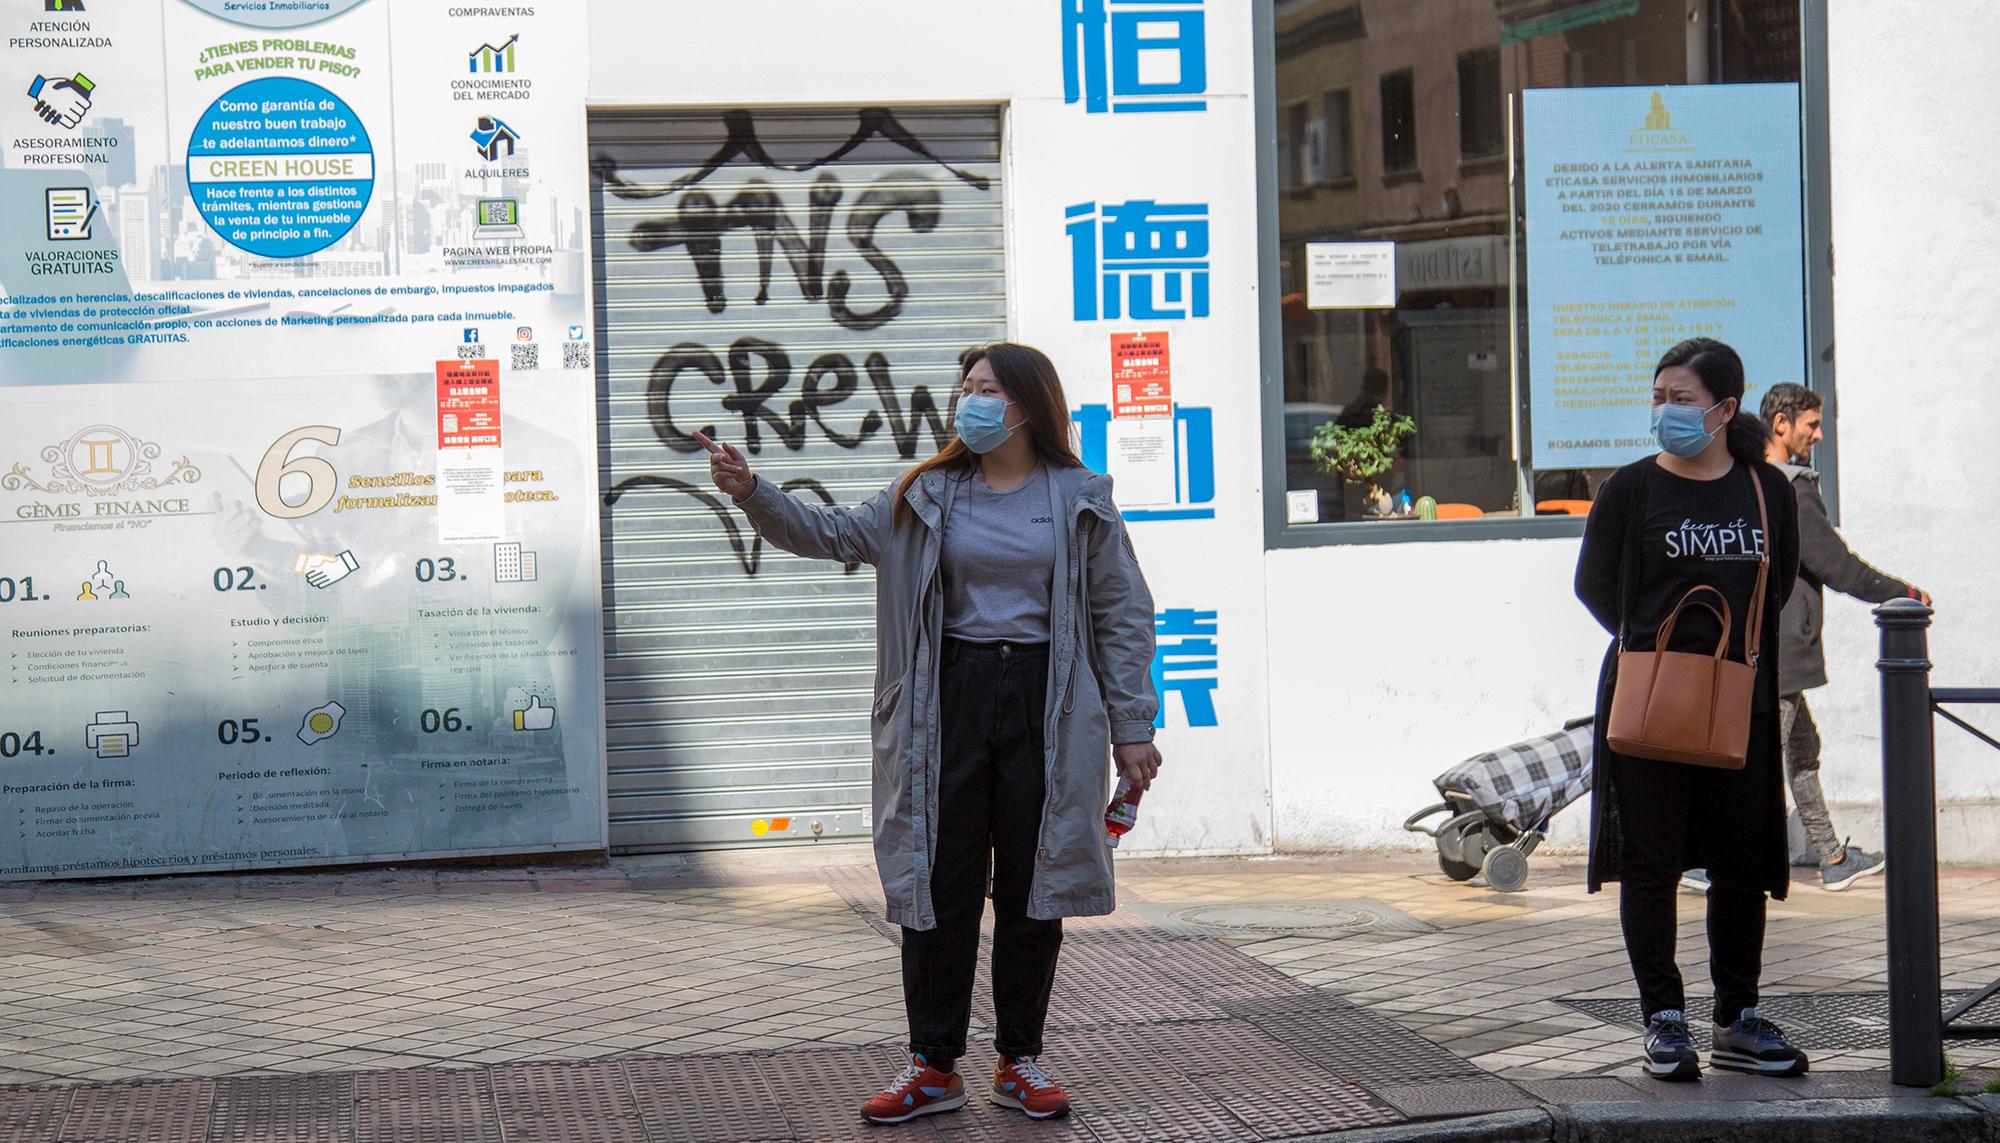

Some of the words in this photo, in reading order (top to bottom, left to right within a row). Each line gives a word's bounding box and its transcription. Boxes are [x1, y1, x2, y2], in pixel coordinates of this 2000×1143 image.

[224, 2, 266, 10] Servicios
[270, 1, 329, 10] Inmobiliarios
[449, 7, 534, 17] COMPRAVENTAS
[30, 21, 90, 32] ATENCIÓN
[10, 38, 112, 48] PERSONALIZADA
[199, 40, 258, 64] ¿TIENES
[263, 39, 356, 59] PROBLEMAS
[194, 63, 234, 80] PARA
[236, 57, 293, 71] VENDER
[298, 57, 315, 69] TU
[319, 60, 360, 78] PISO?
[451, 79, 531, 89] CONOCIMIENTO
[454, 91, 473, 100] DEL
[477, 90, 530, 100] MERCADO
[220, 101, 257, 112] Como
[262, 99, 315, 113] garantía
[319, 99, 335, 110] de
[213, 119, 261, 130] nuestro
[265, 118, 296, 129] buen
[300, 118, 346, 131] trabajo
[13, 138, 118, 149] ASESORAMIENTO
[220, 137, 304, 148] adelantamos
[24, 155, 109, 165] PROFESIONAL
[1554, 164, 1599, 173] DEBIDO
[1634, 161, 1682, 170] ALERTA
[1686, 159, 1752, 169] SANITARIA
[210, 160, 278, 177] CREEN
[285, 159, 354, 175] HOUSE
[465, 168, 529, 179] ALQUILERES
[1602, 174, 1667, 185] SERVICIOS
[1671, 172, 1764, 183] INMOBILIARIOS
[207, 188, 236, 198] Hace
[239, 187, 274, 197] frente
[288, 187, 304, 197] los
[308, 186, 357, 196] distintos
[1570, 189, 1613, 199] PARTIR
[1617, 189, 1642, 198] DEL
[1645, 185, 1665, 197] DÍA
[1706, 186, 1752, 195] MARZO
[202, 201, 255, 212] trámites,
[258, 200, 309, 210] mientras
[313, 200, 362, 211] gestiona
[1562, 204, 1586, 213] DEL
[1590, 203, 1620, 211] 2020
[1624, 201, 1694, 210] CERRAMOS
[1697, 199, 1755, 209] DURANTE
[228, 216, 260, 225] venta
[297, 213, 350, 224] inmueble
[1655, 213, 1721, 223] SIGUIENDO
[251, 229, 300, 241] principio
[314, 228, 332, 238] fin.
[1560, 230, 1613, 239] ACTIVOS
[1617, 228, 1681, 238] MEDIANTE
[1686, 226, 1743, 236] SERVICIO
[443, 248, 483, 256] PAGINA
[486, 247, 509, 255] WEB
[513, 245, 552, 254] PROPIA
[1592, 241, 1679, 252] TELETRABAJO
[1683, 240, 1707, 249] POR
[1711, 237, 1732, 248] VÍA
[25, 250, 118, 262] VALORACIONES
[1687, 253, 1728, 262] EMAIL.
[31, 262, 113, 275] GRATUITAS
[76, 293, 131, 303] herencias,
[134, 290, 224, 302] descalificaciones
[244, 289, 295, 299] viviendas,
[298, 287, 371, 297] cancelaciones
[391, 284, 439, 295] embargo,
[30, 308, 80, 318] viviendas
[100, 307, 154, 318] protección
[158, 306, 192, 315] oficial.
[77, 321, 150, 331] comunicación
[155, 321, 190, 331] propio,
[216, 318, 262, 327] acciones
[281, 315, 334, 327] Marketing
[336, 314, 408, 325] personalizada
[411, 315, 435, 323] para
[438, 313, 462, 321] cada
[62, 335, 124, 346] energéticas
[128, 333, 189, 344] GRATUITAS.
[1549, 439, 1611, 449] ROGAMOS
[255, 425, 341, 519] 6
[349, 472, 435, 488] Sencillos
[95, 499, 189, 516] FINANCE
[53, 521, 113, 532] Financiamos
[1680, 519, 1720, 537] keep
[1729, 518, 1747, 528] it
[1665, 529, 1764, 558] SIMPLE
[416, 557, 467, 582] 03.
[214, 566, 267, 592] 02.
[418, 609, 463, 618] Tasación
[494, 606, 541, 614] vivienda:
[231, 619, 270, 627] Estudio
[282, 615, 329, 624] decisión:
[12, 628, 70, 638] Reuniones
[73, 624, 150, 636] preparatorias:
[248, 638, 300, 648] Compromiso
[449, 641, 490, 649] Validación
[504, 639, 538, 647] tasación
[248, 652, 295, 660] Aprobación
[305, 649, 334, 657] mejora
[449, 653, 497, 662] Verificación
[28, 663, 79, 671] Condiciones
[249, 664, 285, 673] Apertura
[80, 672, 145, 681] documentación
[420, 708, 472, 733] 06.
[218, 718, 272, 744] 05.
[0, 731, 55, 758] 04.
[421, 760, 450, 769] Firma
[219, 772, 261, 781] Periodo
[280, 767, 331, 777] reflexión:
[3, 782, 69, 795] Preparación
[102, 779, 135, 788] firma:
[500, 777, 553, 786] compraventa
[534, 787, 579, 796] hipotecario
[35, 806, 66, 814] Repaso
[91, 801, 133, 810] operación
[253, 804, 288, 812] Decisión
[455, 805, 486, 813] Entrega
[134, 813, 159, 821] previa
[201, 851, 257, 862] préstamos
[261, 846, 319, 860] personales.
